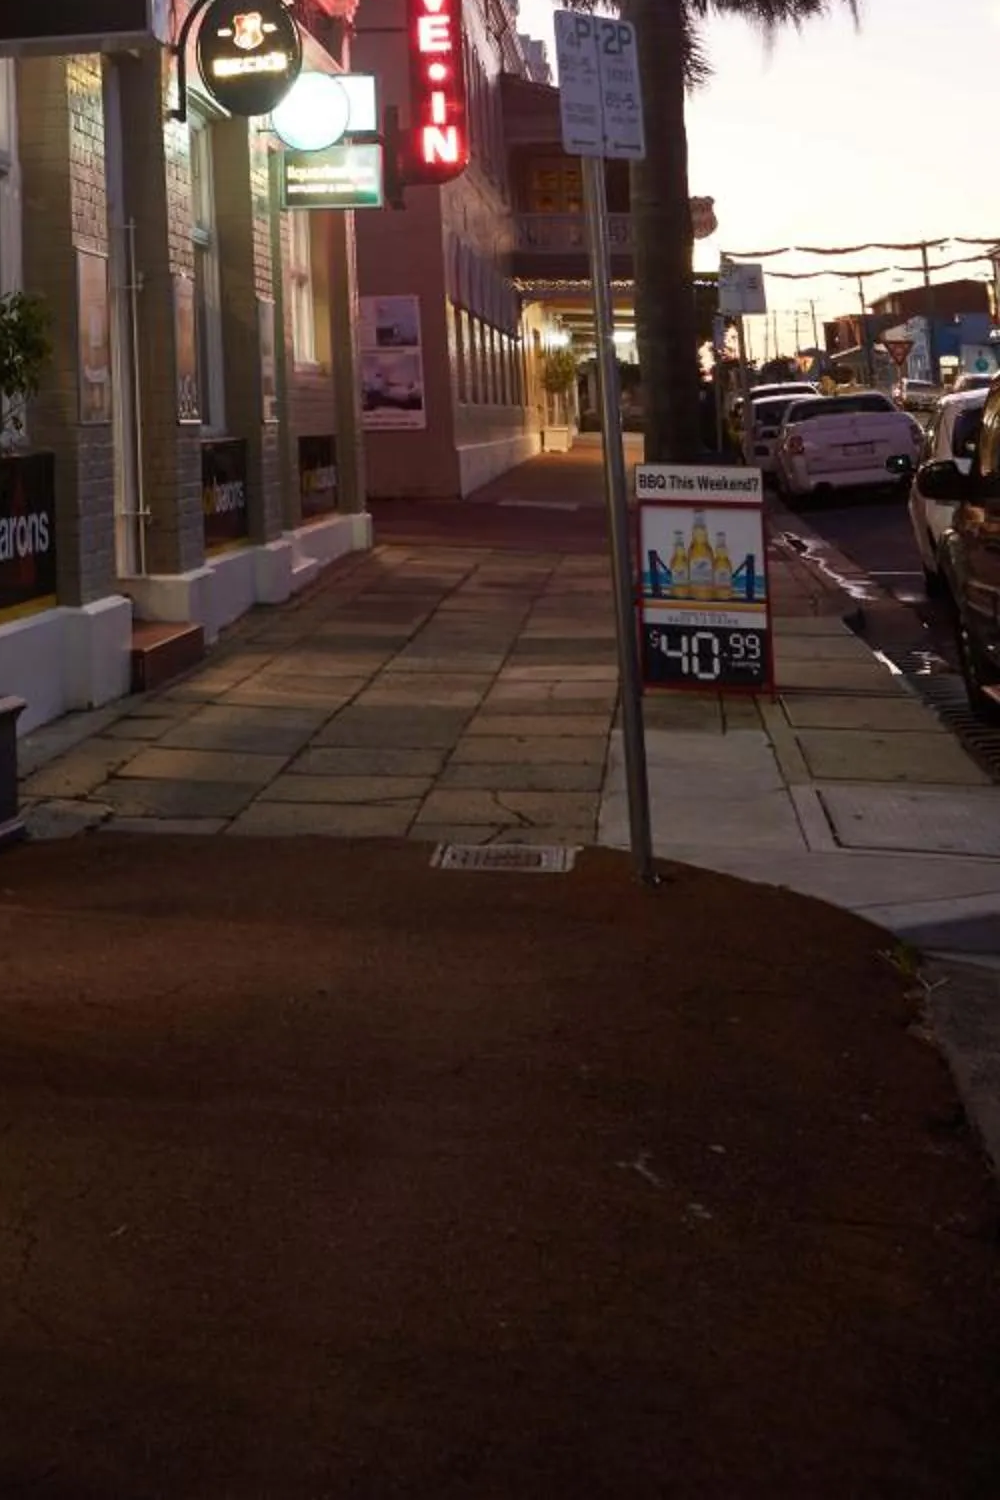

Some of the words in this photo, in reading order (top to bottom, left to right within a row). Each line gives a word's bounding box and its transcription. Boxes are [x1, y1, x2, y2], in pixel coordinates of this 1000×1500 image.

[601, 23, 632, 55] 2P
[639, 473, 666, 490] BBQ
[668, 475, 694, 491] This
[697, 475, 759, 492] Weekend?
